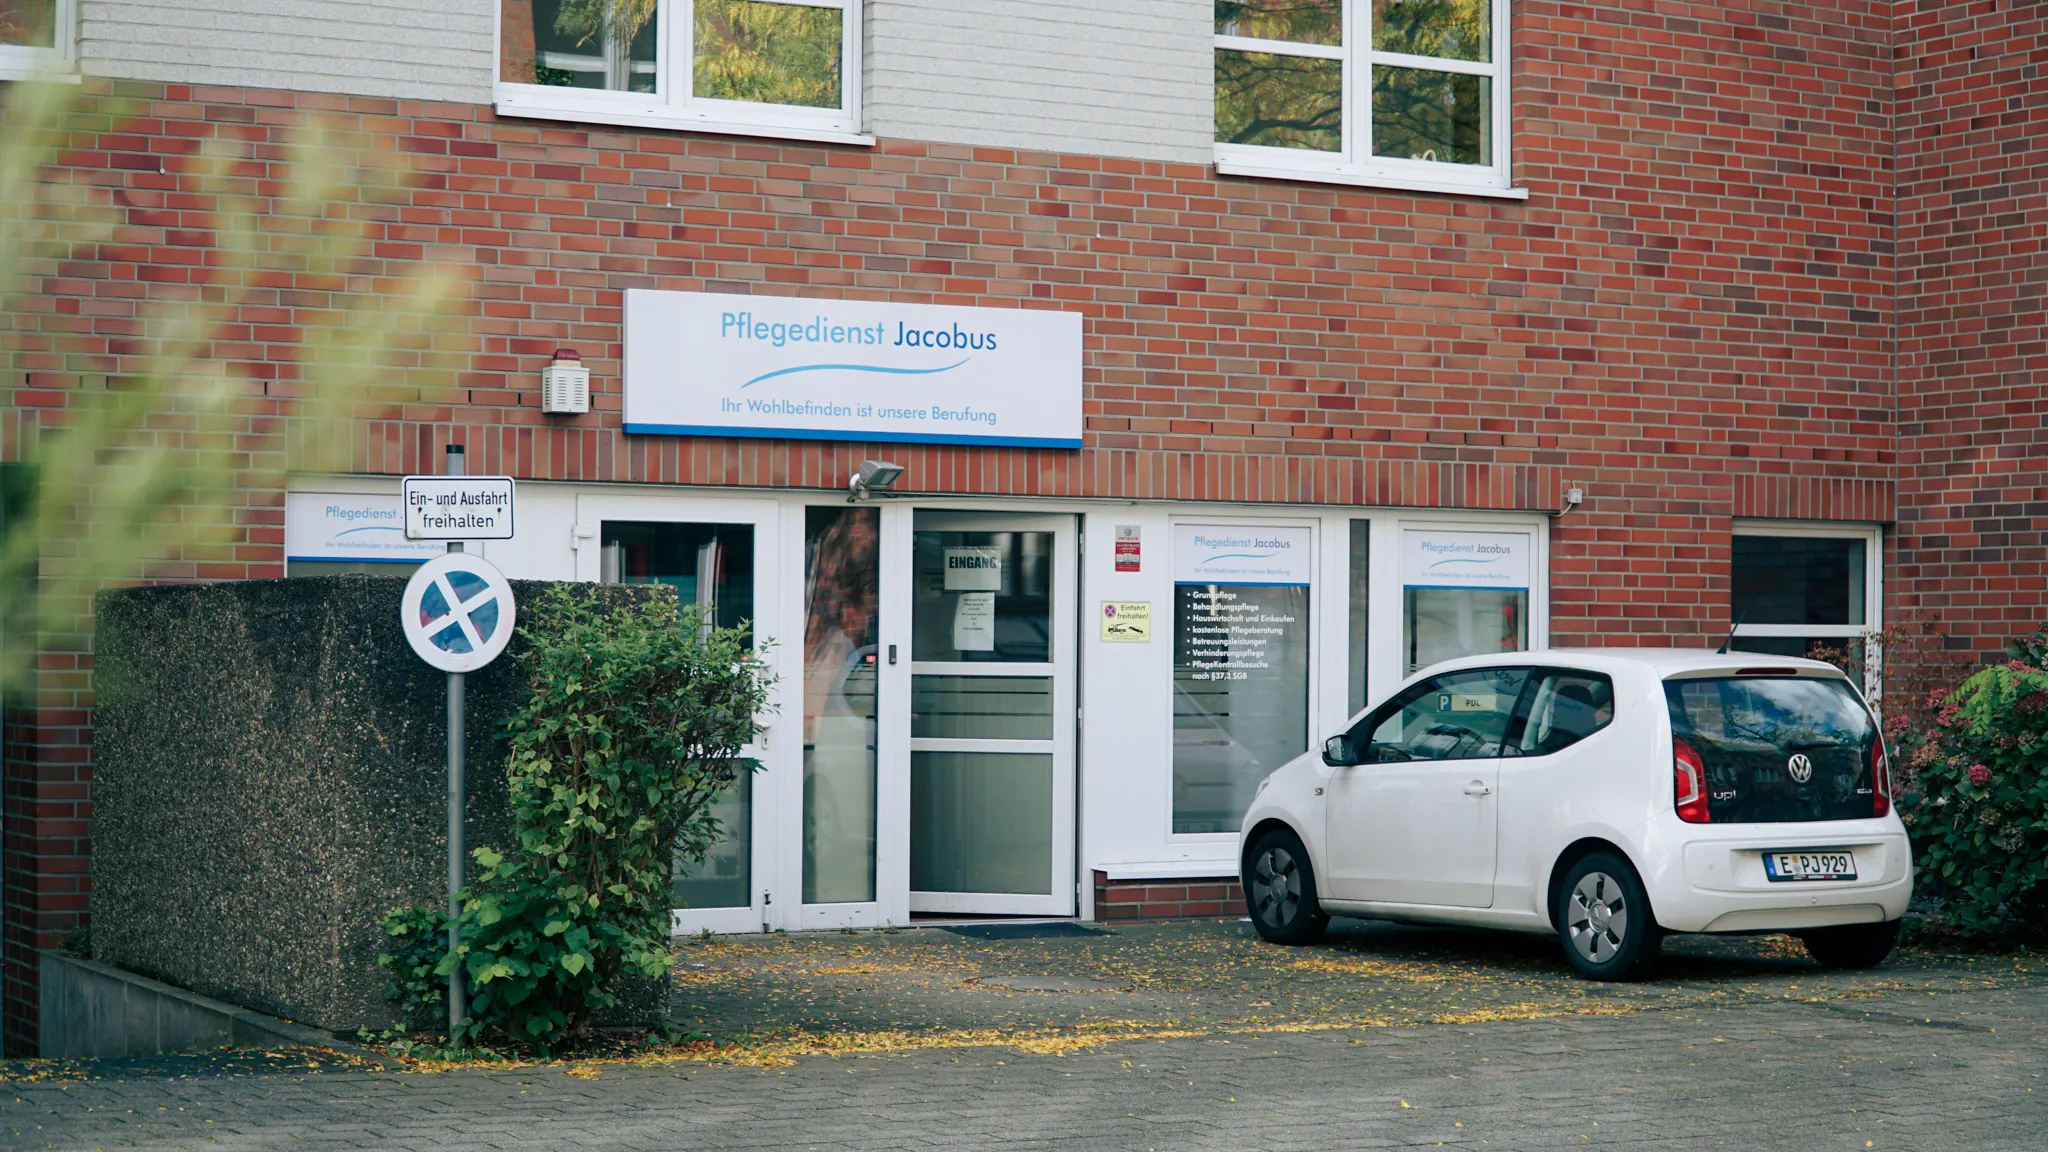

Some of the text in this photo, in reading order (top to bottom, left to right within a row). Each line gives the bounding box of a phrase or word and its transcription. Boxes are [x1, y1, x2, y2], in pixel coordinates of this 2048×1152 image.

[721, 312, 997, 351] Pflegedienst Jacobus
[721, 398, 997, 426] Ihr Wohlbefinden ist unsere Berufung
[410, 491, 508, 505] Ein- und Ausfahrt
[325, 506, 397, 521] Pflegedienst
[423, 514, 494, 528] freihalten
[1194, 536, 1291, 549] Pflegedienst Jacobus
[1421, 541, 1511, 554] Pflegedienst Jacobus
[949, 556, 997, 569] EINGANG
[1192, 591, 1237, 600] Grunpflege
[1192, 602, 1259, 612] Behandlungspflege
[1192, 614, 1295, 623] Hauswirtschaft und Einkaufen
[1192, 626, 1284, 636] kostenlose Pflegeberatung
[1192, 637, 1267, 647] Betreuungsleistungen
[1192, 649, 1265, 659] Verhinderungspflege
[1192, 672, 1209, 680] nach
[1232, 672, 1248, 680] SGB
[1440, 696, 1481, 710] P PDL
[1713, 789, 1737, 801] up!
[1780, 856, 1792, 874] E
